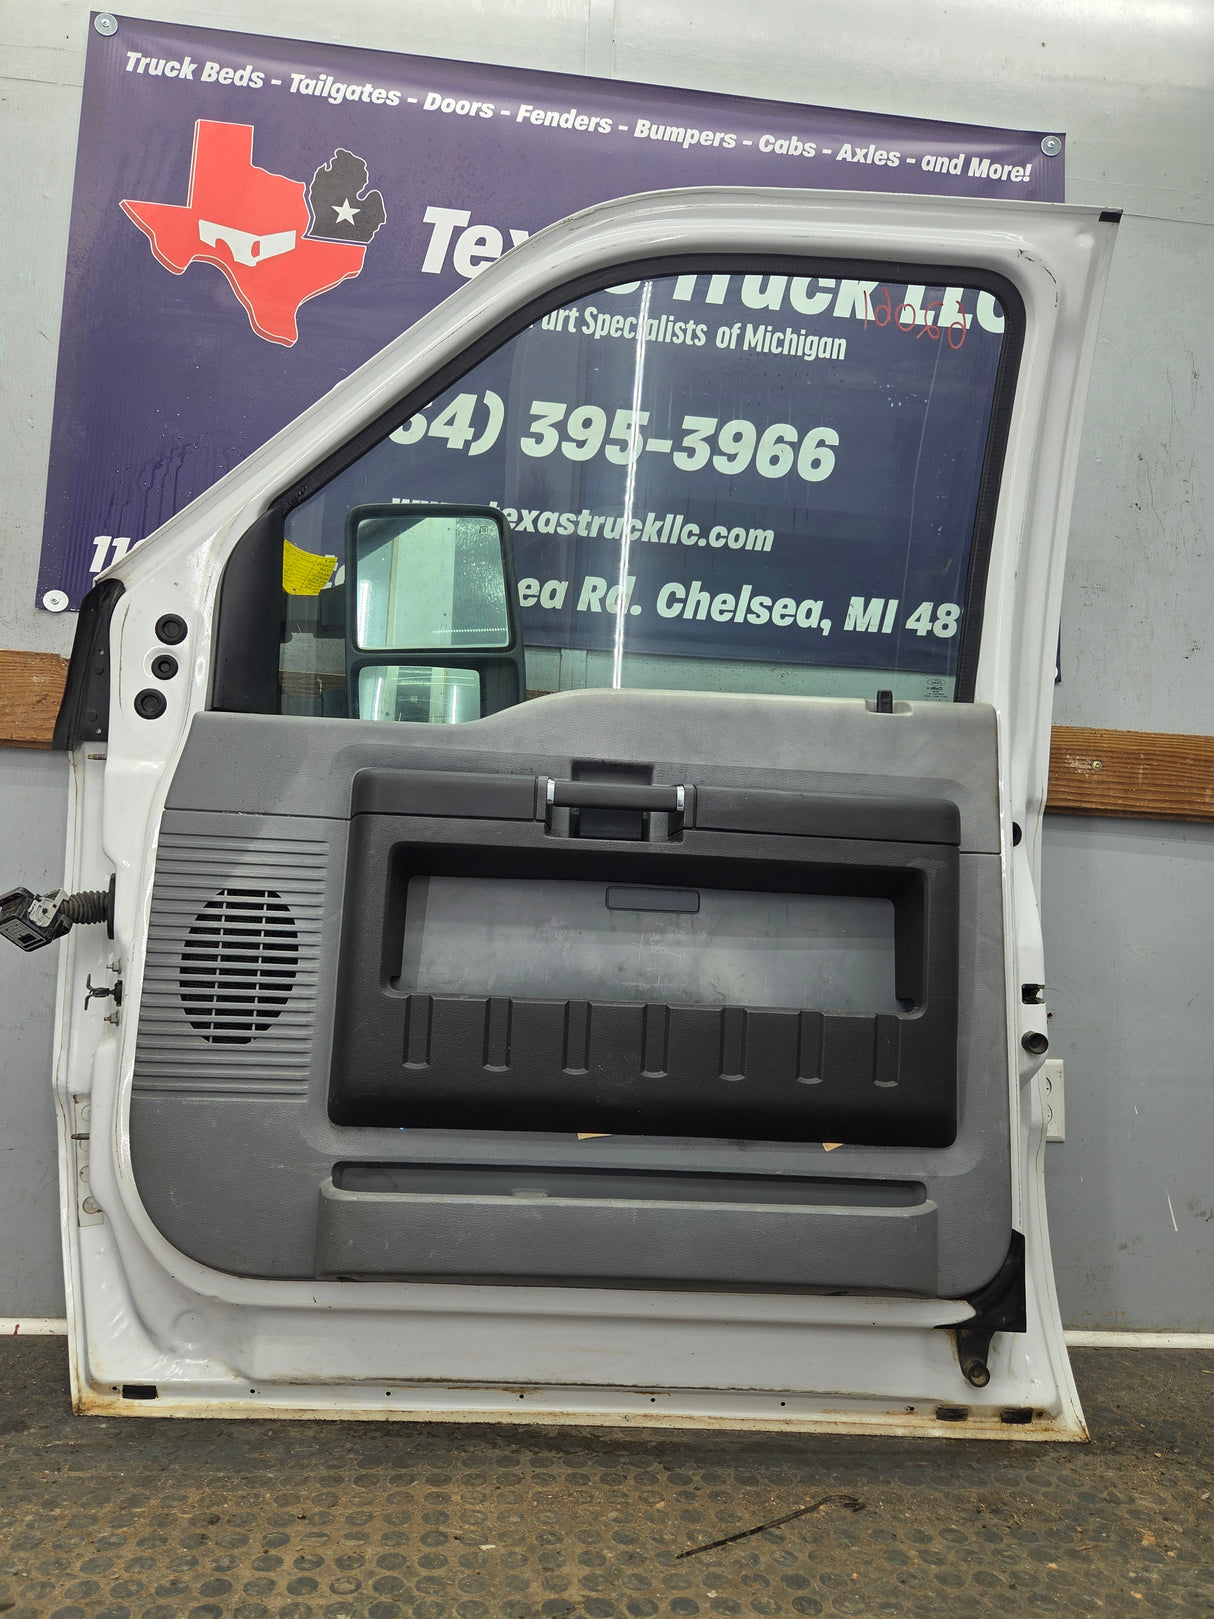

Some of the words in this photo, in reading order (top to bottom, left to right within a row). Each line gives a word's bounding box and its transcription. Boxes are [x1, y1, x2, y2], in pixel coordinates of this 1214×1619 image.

[125, 51, 198, 80] Truck
[201, 61, 264, 88] Beds
[289, 73, 401, 106] Tailgates
[423, 92, 495, 119] Doors
[516, 104, 612, 133] Fenders
[634, 118, 736, 150] Bumpers
[758, 134, 816, 158] Cabs
[836, 143, 901, 168] Axles
[921, 153, 965, 175] and
[968, 157, 1032, 182] More!
[529, 307, 579, 333] art
[582, 306, 707, 346] Specalists
[716, 323, 742, 347] of
[743, 323, 847, 361] Michigan
[520, 400, 840, 482] 395-3966
[89, 535, 146, 572] 11
[577, 576, 642, 615] Rd.
[657, 580, 832, 636] Chelsea,
[844, 597, 899, 634] MI
[905, 602, 963, 638] 48
